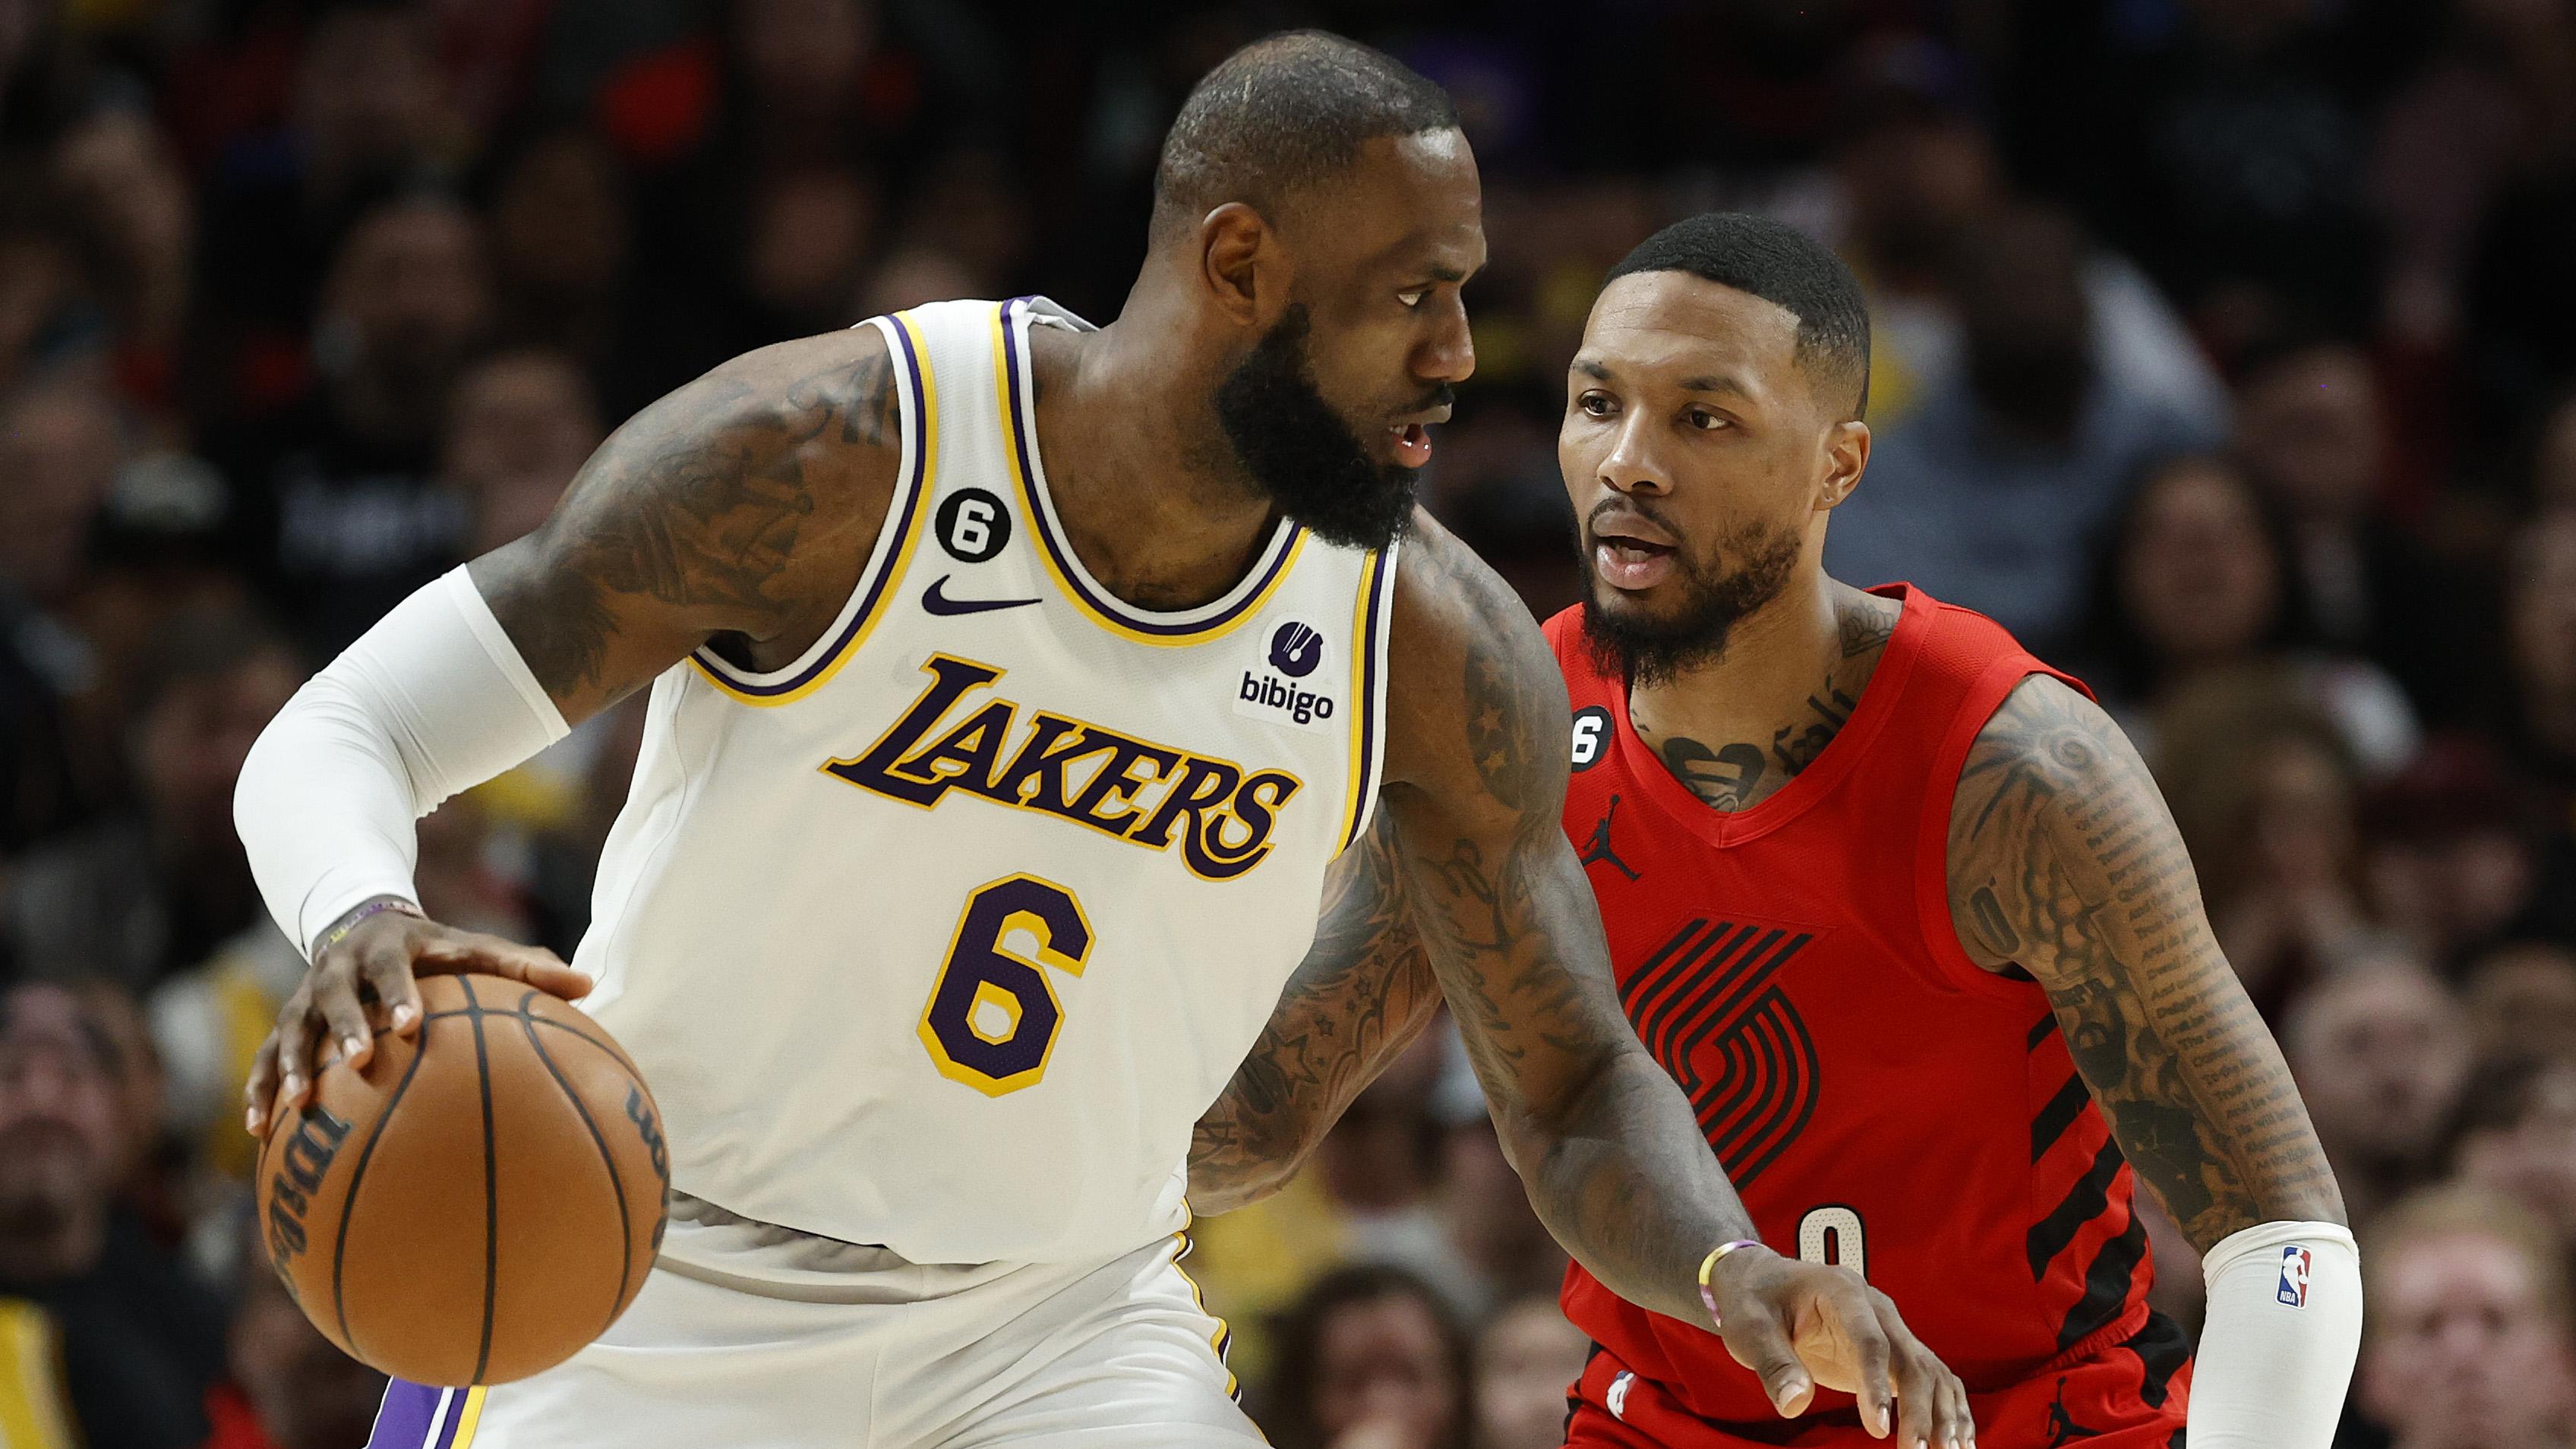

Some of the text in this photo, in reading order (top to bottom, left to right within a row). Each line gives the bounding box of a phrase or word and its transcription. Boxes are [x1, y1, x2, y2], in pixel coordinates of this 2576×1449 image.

[951, 498, 995, 554] 6
[1239, 671, 1334, 724] bibigo
[1571, 715, 1602, 763] 6
[817, 651, 1304, 882] LAKERS
[916, 872, 1096, 1099] 6
[2280, 1290, 2295, 1303] NBA
